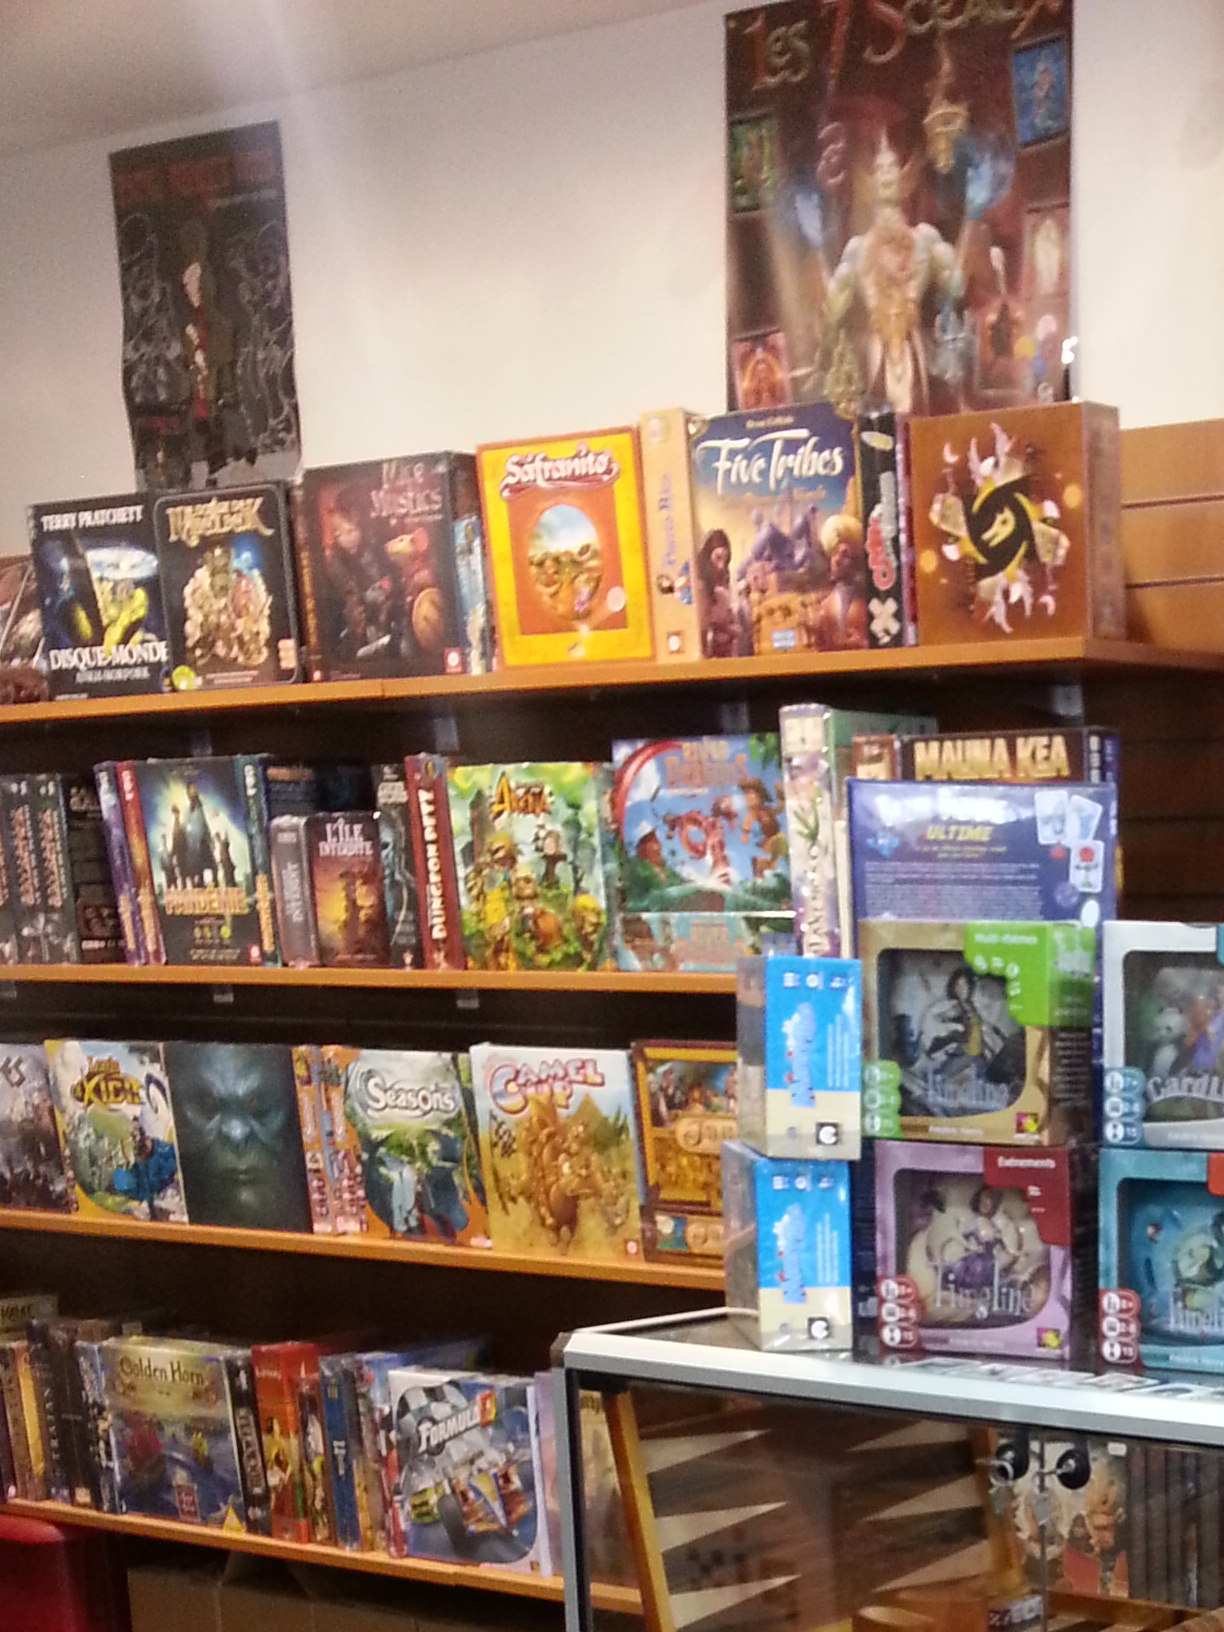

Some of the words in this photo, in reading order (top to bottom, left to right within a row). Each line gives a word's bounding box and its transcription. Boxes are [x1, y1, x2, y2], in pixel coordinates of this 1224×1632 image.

[504, 446, 618, 488] Safranito
[696, 438, 767, 494] Five
[749, 428, 845, 490] Tribes
[41, 514, 76, 532] TERRY
[78, 505, 144, 529] PRATCHETT
[913, 737, 1012, 781] MAUNA
[1015, 734, 1070, 778] KEA
[926, 825, 993, 842] ULTIME
[367, 1075, 455, 1114] Seasons
[490, 1058, 605, 1114] CAMEL
[119, 1356, 168, 1382] Golden
[170, 1361, 205, 1385] Horn
